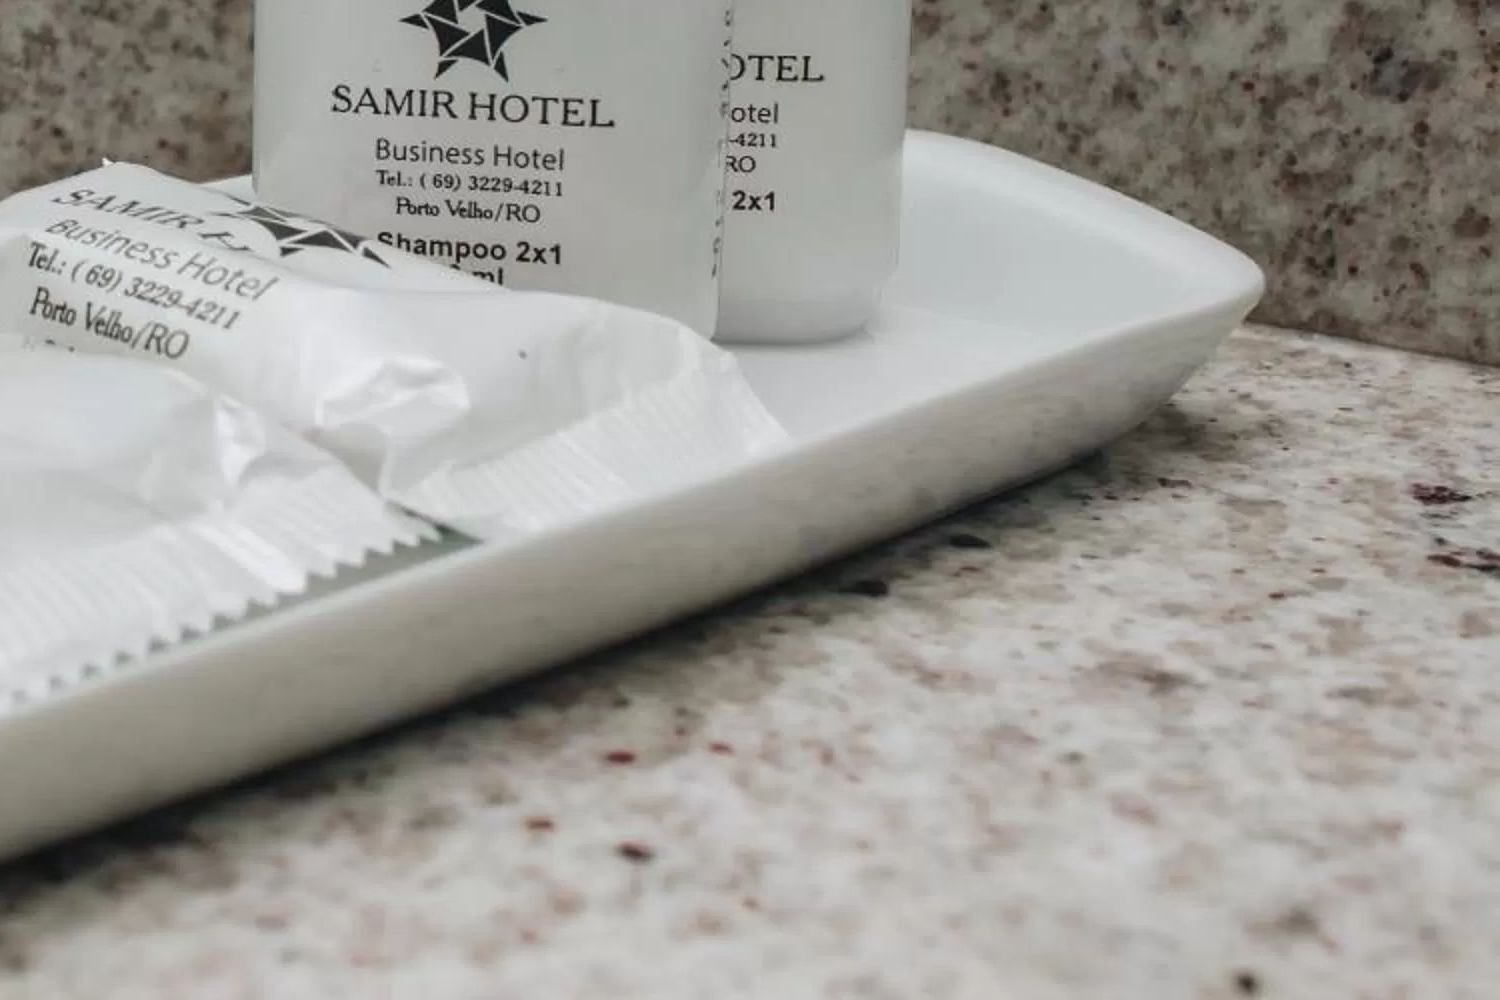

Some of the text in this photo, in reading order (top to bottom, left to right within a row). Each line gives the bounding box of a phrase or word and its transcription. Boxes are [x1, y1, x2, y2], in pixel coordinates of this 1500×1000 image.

[729, 53, 825, 82] OTEL
[331, 84, 616, 128] SAMIR HOTEL
[731, 102, 779, 124] otel
[375, 137, 565, 171] Business Hotel
[375, 169, 413, 187] Tel.:
[467, 175, 564, 197] 3229-4211
[52, 188, 204, 229] SAMIR
[395, 196, 541, 223] Porto Velho/RO
[732, 190, 776, 211] 2x1
[45, 218, 180, 269] Business
[177, 252, 281, 300] Hotel
[515, 241, 562, 265] 2x1
[28, 241, 67, 275] Tel.:
[124, 276, 240, 330] 3229-4211
[29, 286, 190, 360] Porto Velho/RO
